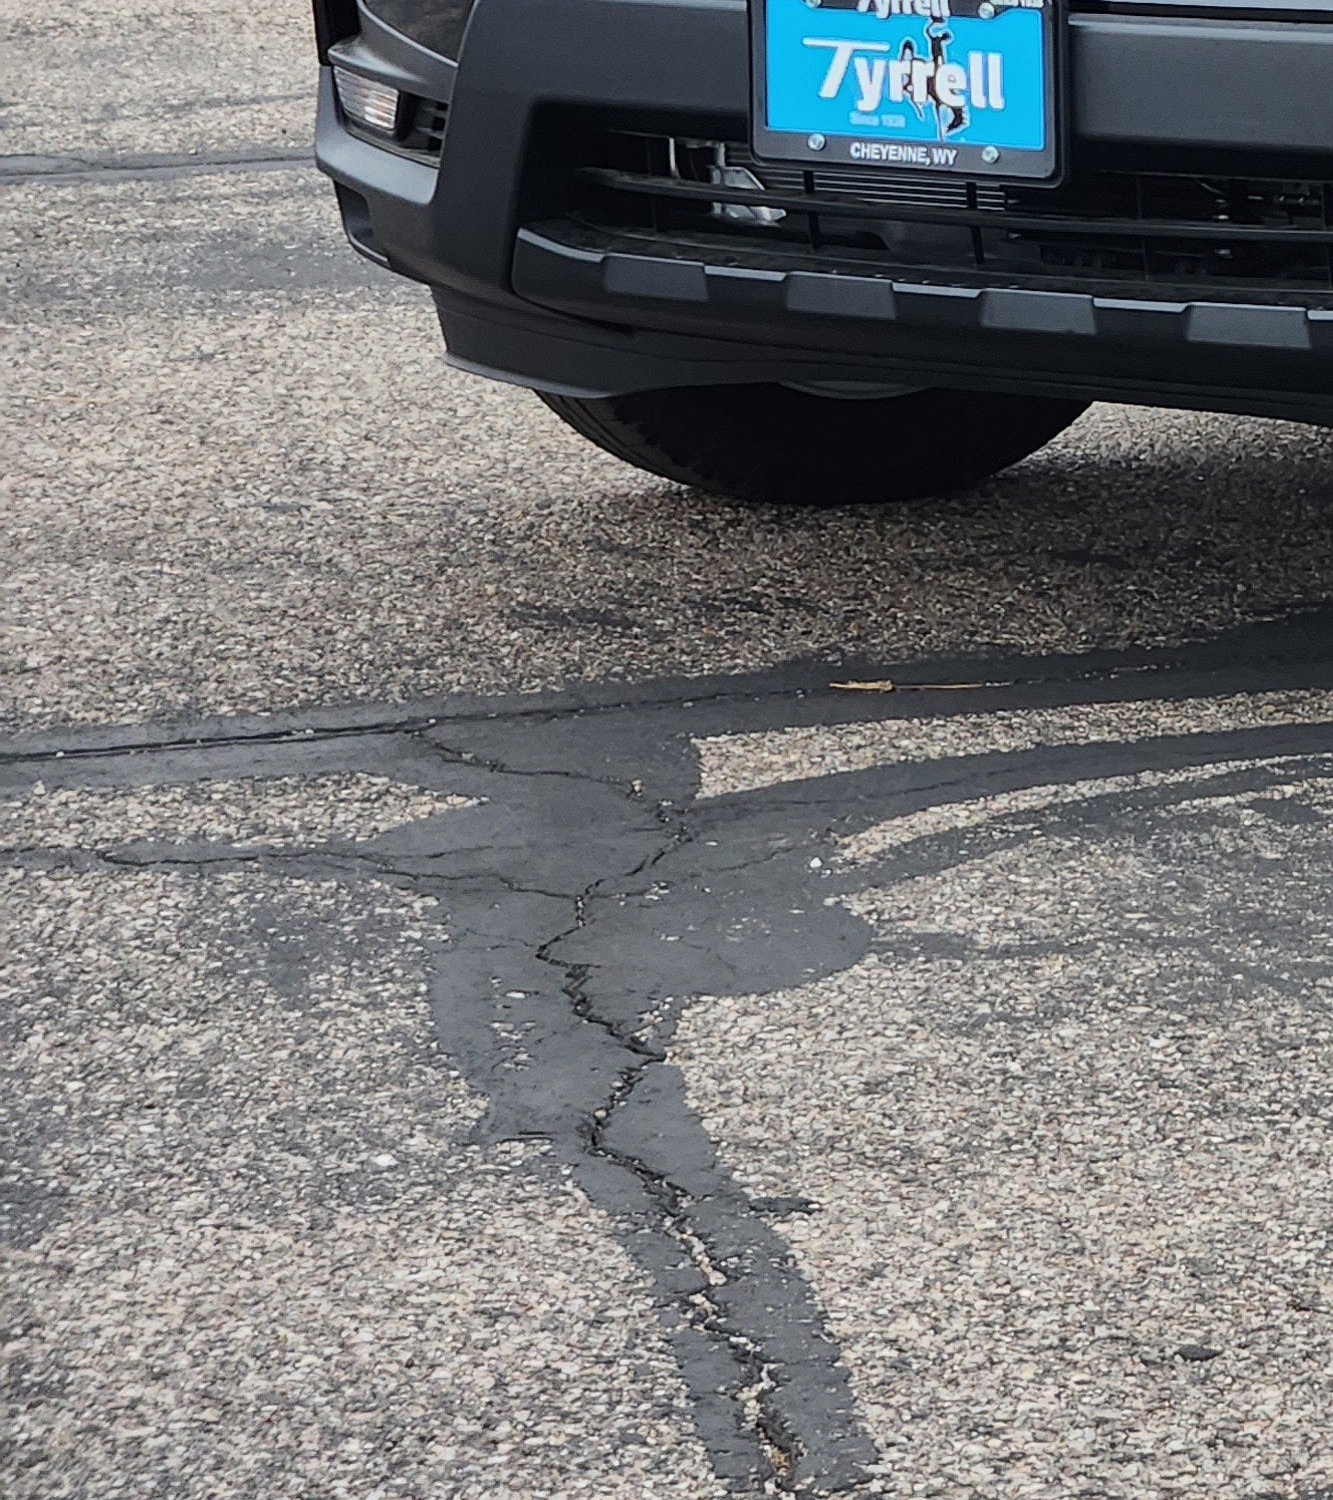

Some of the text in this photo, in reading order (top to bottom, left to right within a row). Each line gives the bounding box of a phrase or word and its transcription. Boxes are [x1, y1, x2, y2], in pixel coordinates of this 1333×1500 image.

[802, 36, 1006, 113] Tyrrell
[850, 141, 958, 167] CHEYENNE, WY
